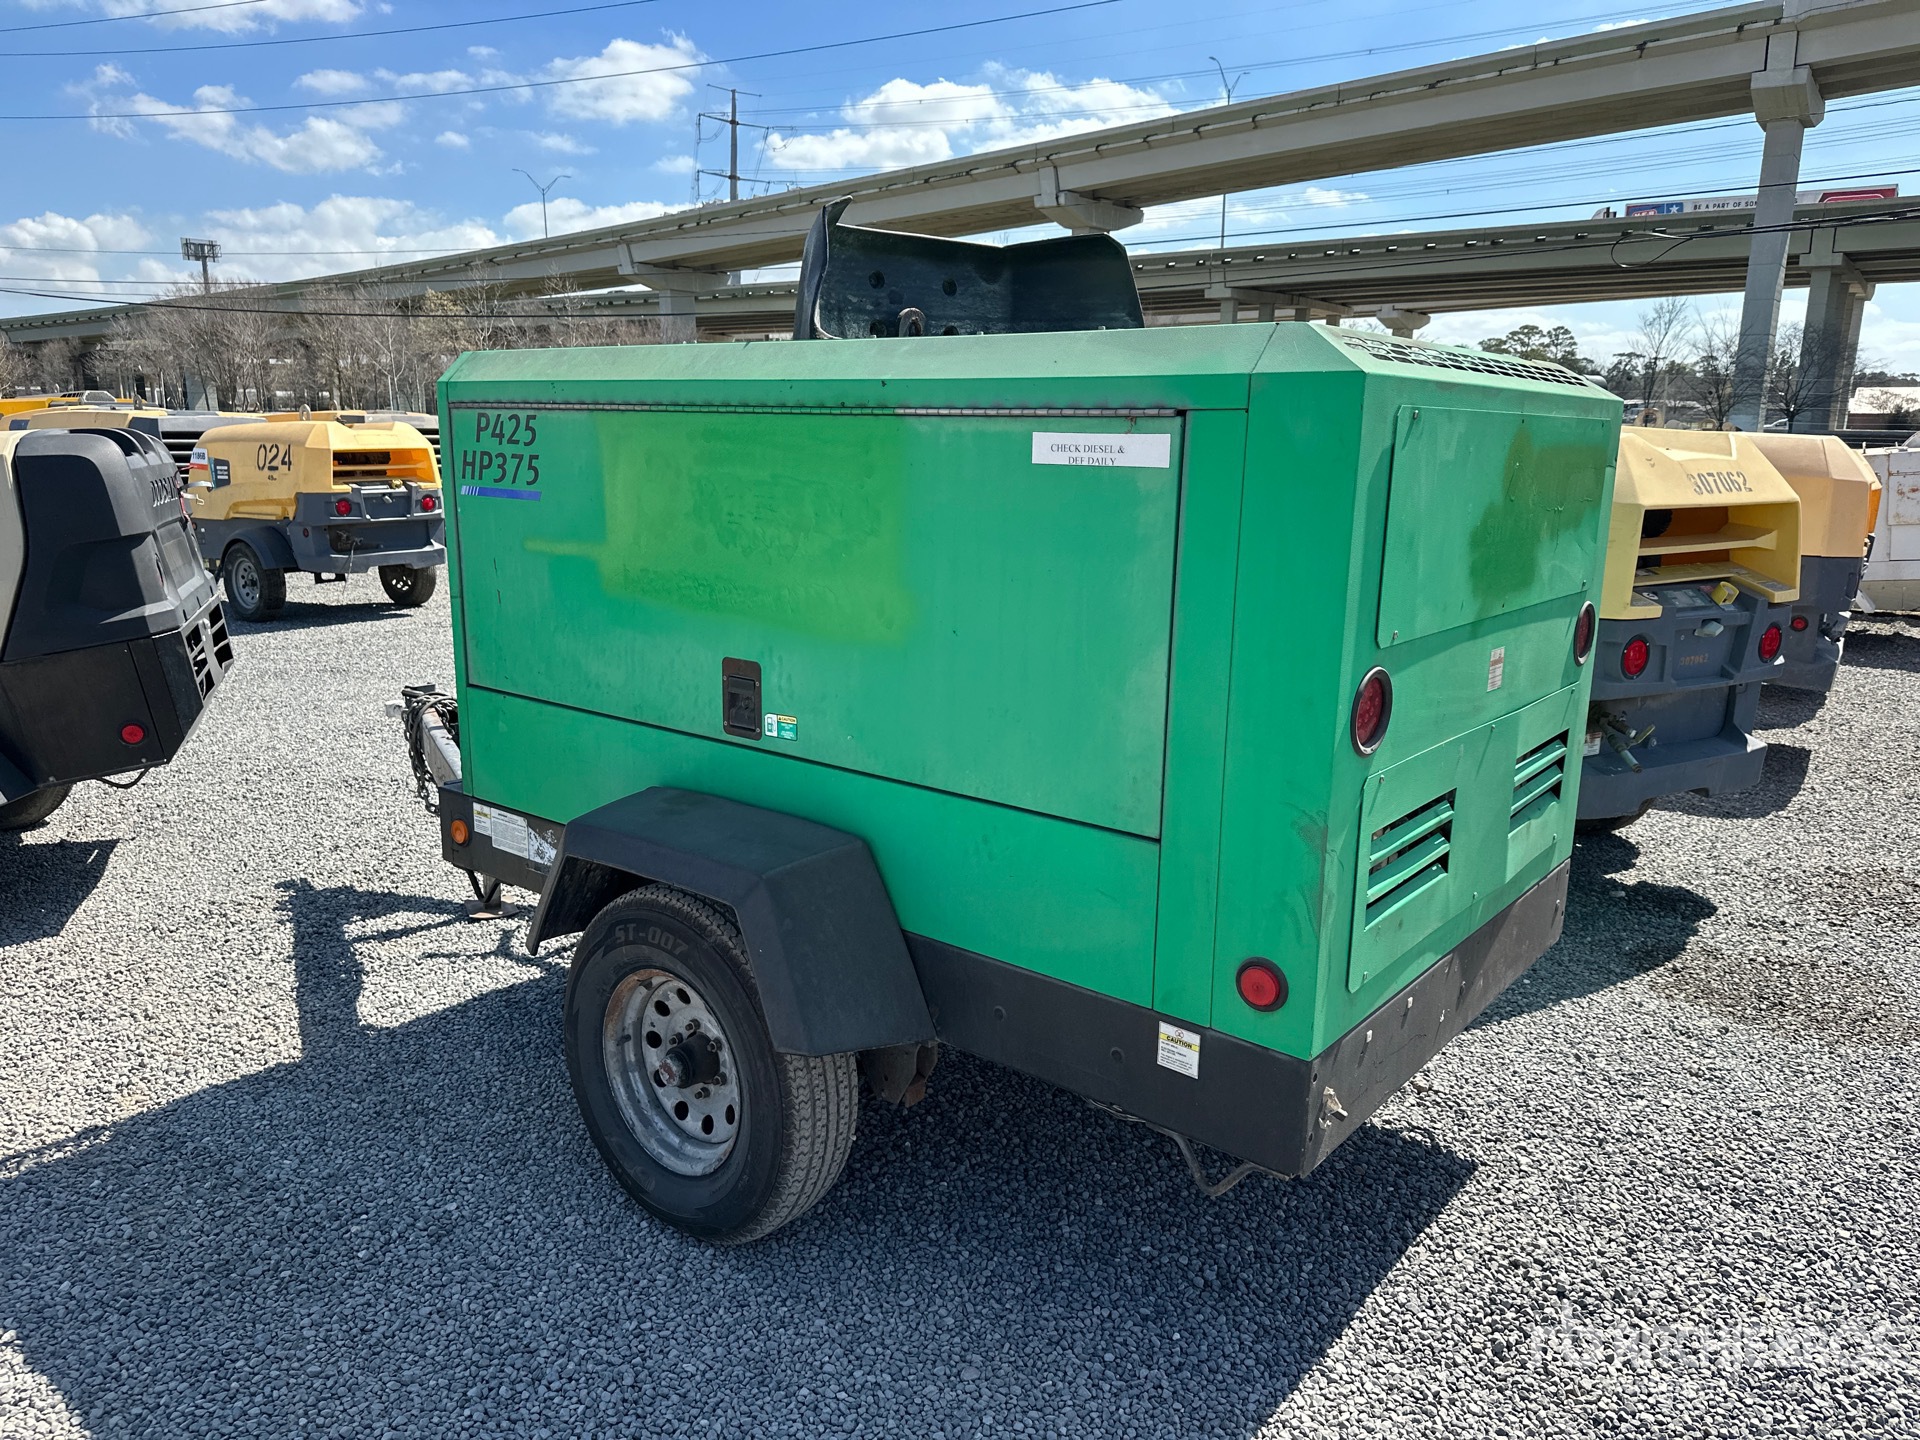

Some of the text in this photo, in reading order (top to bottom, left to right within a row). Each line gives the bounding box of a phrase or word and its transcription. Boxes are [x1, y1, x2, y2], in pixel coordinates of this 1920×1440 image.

[475, 412, 538, 447] P425
[256, 443, 292, 471] 024
[1050, 443, 1125, 454] CHECK DIESEL &
[1068, 456, 1117, 466] DEF DAILY
[461, 449, 540, 486] HP375
[614, 922, 689, 955] ST-007
[1166, 1035, 1193, 1049] CAUTION
